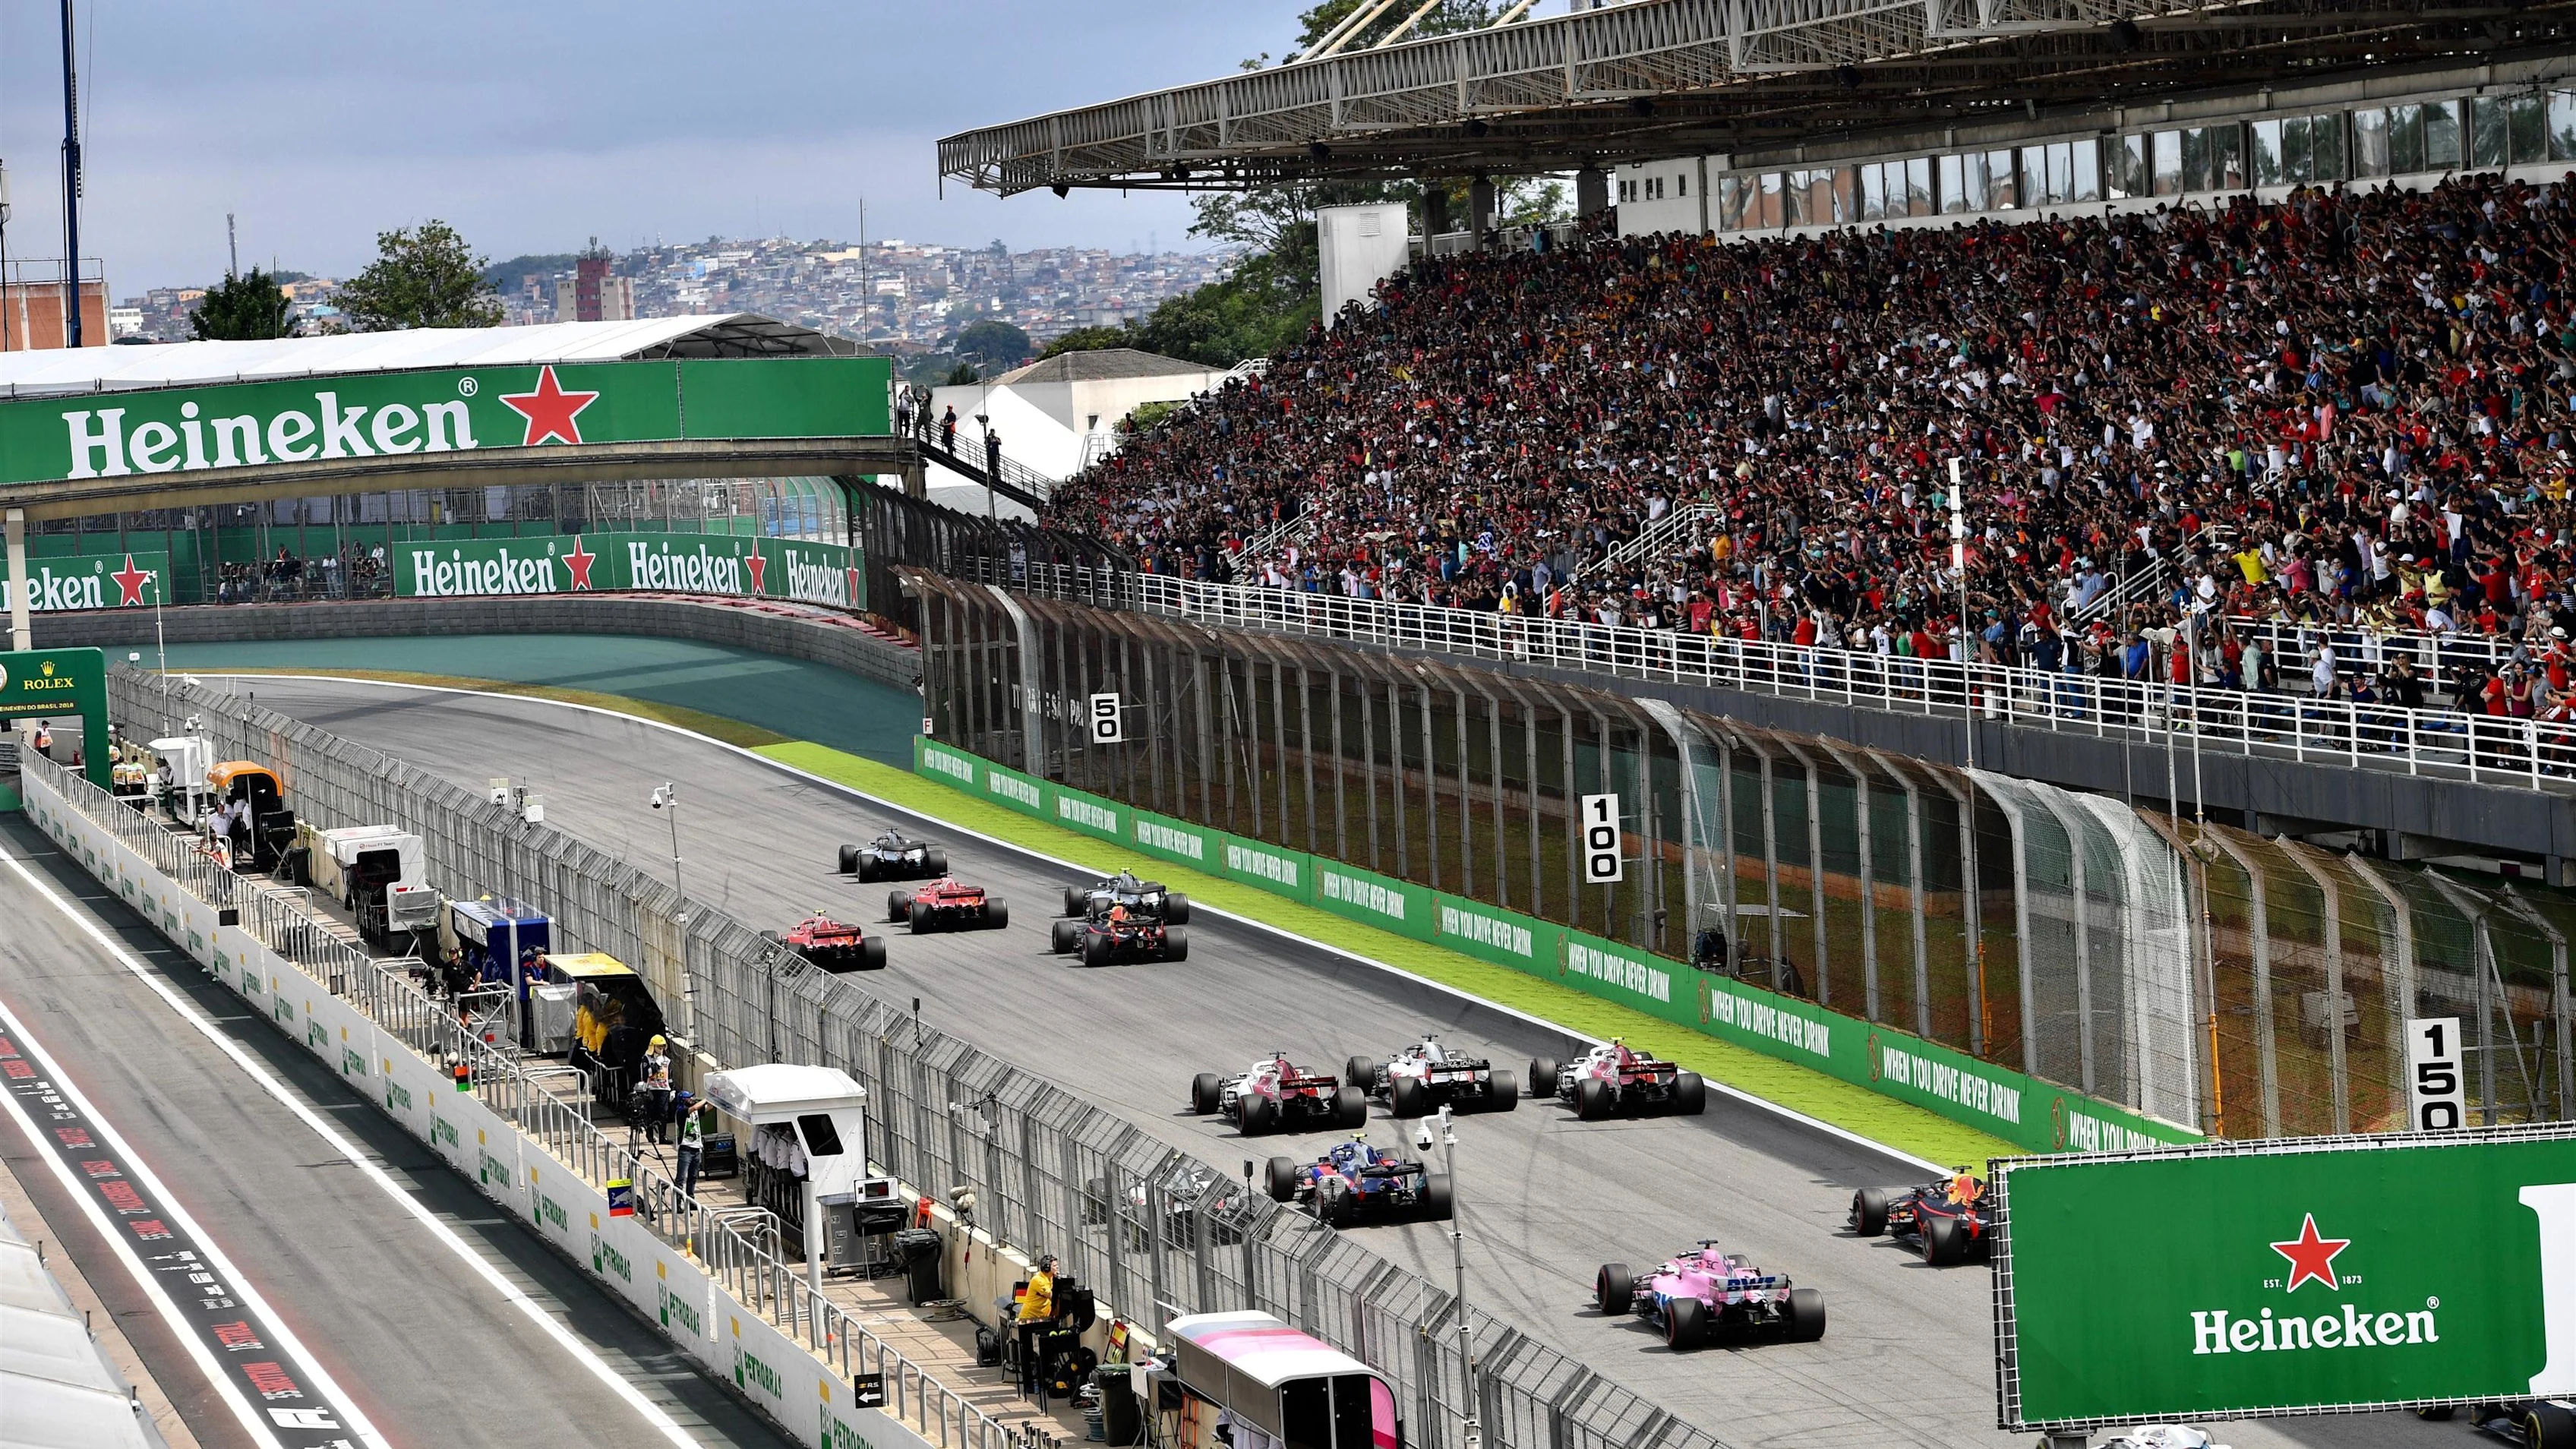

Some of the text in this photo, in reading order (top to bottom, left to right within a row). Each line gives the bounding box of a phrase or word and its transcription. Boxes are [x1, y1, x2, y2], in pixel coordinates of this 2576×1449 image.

[62, 391, 478, 479] Heineken
[412, 548, 556, 596] Heineken
[628, 541, 741, 594] Heineken
[785, 549, 847, 607] Heineken
[24, 677, 74, 690] ROLEX
[925, 721, 930, 731] F
[1589, 798, 1617, 877] 100
[1323, 870, 1405, 921] WHEN YOU DRIVE NEVER DRINK
[1441, 904, 1533, 958] WHEN YOU DRIVE NEVER DRINK
[1567, 940, 1670, 1005] WHEN YOU DRIVE NEVER DRINK
[1711, 988, 1830, 1059] WHEN YOU DRIVE NEVER DRINK
[1883, 1044, 2020, 1125] WHEN YOU DRIVE NEVER DRINK
[2069, 1108, 2099, 1154] WHEN
[488, 1154, 510, 1189] PETROBRAS
[542, 1194, 568, 1233] PETROBRAS
[602, 1240, 631, 1283] PETROBRAS
[1726, 1277, 1776, 1292] BWT
[2264, 1275, 2363, 1288] EST. 1873
[670, 1291, 700, 1337] PETROBRAS
[2190, 1304, 2439, 1355] Heineken
[744, 1350, 782, 1400] PETROBRAS
